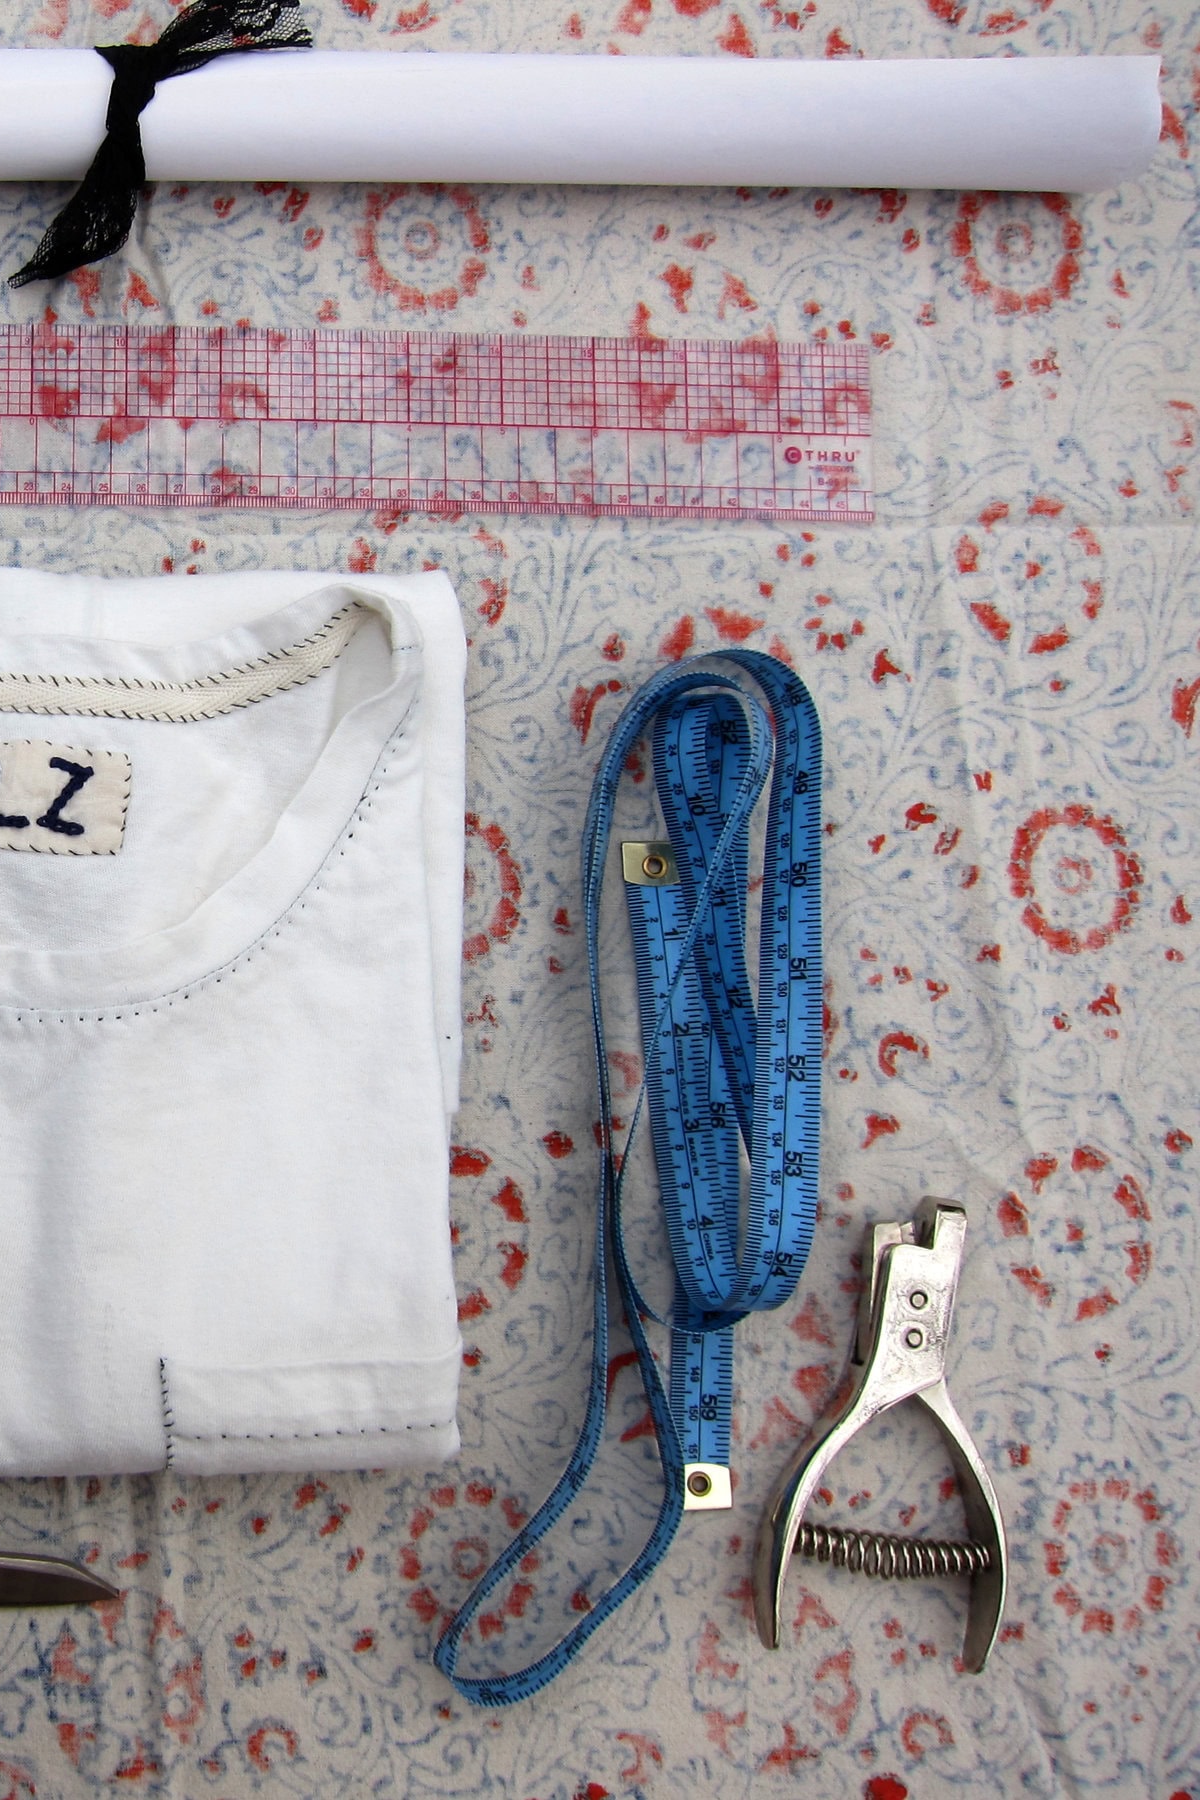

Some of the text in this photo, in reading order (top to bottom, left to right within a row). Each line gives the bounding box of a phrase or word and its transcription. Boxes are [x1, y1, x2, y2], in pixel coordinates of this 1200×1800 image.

[24, 337, 31, 345] 9
[117, 338, 126, 347] 10
[305, 341, 314, 350] 12
[583, 349, 592, 358] 15
[29, 417, 35, 426] 0
[218, 420, 224, 428] 2
[313, 422, 318, 431] 3
[407, 424, 413, 433] 4
[500, 426, 505, 435] 5
[593, 429, 599, 437] 6
[805, 451, 855, 462] THRU
[24, 482, 33, 491] 23
[61, 483, 71, 491] 24
[99, 483, 108, 492] 25
[136, 484, 146, 493] 26
[173, 484, 183, 493] 27
[211, 485, 220, 494] 28
[248, 486, 258, 495] 29
[285, 487, 295, 496] 30
[323, 487, 332, 496] 31
[360, 488, 370, 497] 32
[397, 489, 407, 498] 33
[617, 495, 627, 504] 39
[727, 497, 737, 507] 42
[800, 500, 809, 509] 44
[786, 763, 795, 778] 124
[782, 797, 792, 813] 125
[667, 743, 678, 756] 24
[673, 783, 684, 796] 25
[693, 857, 705, 870] 27
[712, 971, 722, 984] 30
[779, 868, 790, 884] 127
[688, 793, 743, 1009] 10 11 12
[777, 904, 788, 922] 128
[710, 720, 739, 1129] 52 56
[777, 942, 788, 959] 129
[771, 683, 810, 1278] 48 49 50 51 52 53 54
[777, 981, 788, 998] 130
[662, 1030, 672, 1038] 5
[776, 1018, 786, 1034] 131
[666, 1068, 675, 1076] 6
[774, 1056, 785, 1074] 132
[664, 927, 715, 1228] 1 2 3 4
[773, 1094, 784, 1111] 133
[772, 1131, 782, 1148] 134
[688, 1137, 700, 1177] MADE IN
[770, 1169, 781, 1186] 135
[686, 1219, 697, 1230] 10
[768, 1208, 780, 1227] 136
[703, 1233, 714, 1260] CHINA
[695, 1256, 706, 1267] 11
[762, 1249, 775, 1266] 137
[688, 1365, 700, 1459] 149 150 151
[701, 1393, 718, 1421] 59
